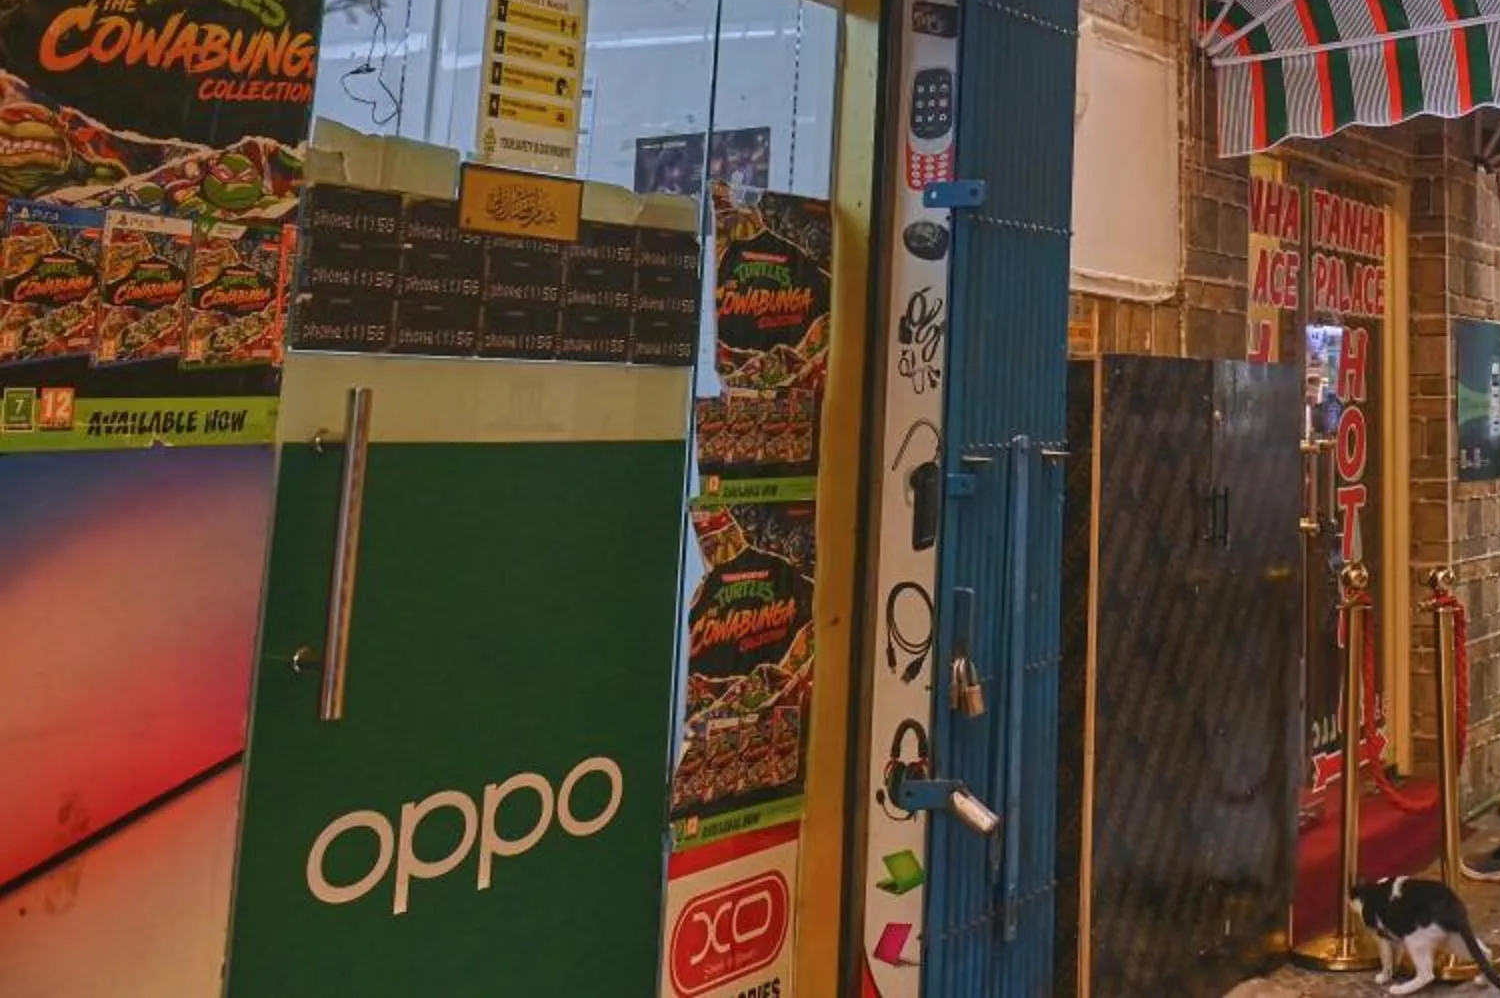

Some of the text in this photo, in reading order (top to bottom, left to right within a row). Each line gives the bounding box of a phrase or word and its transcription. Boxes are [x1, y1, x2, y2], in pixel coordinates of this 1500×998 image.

[1312, 188, 1385, 259] TANHA
[1312, 252, 1385, 318] PALACE
[43, 390, 74, 413] 12
[87, 408, 249, 436] AVAILABLE NOW
[307, 757, 623, 915] oppo
[690, 890, 773, 967] XO
